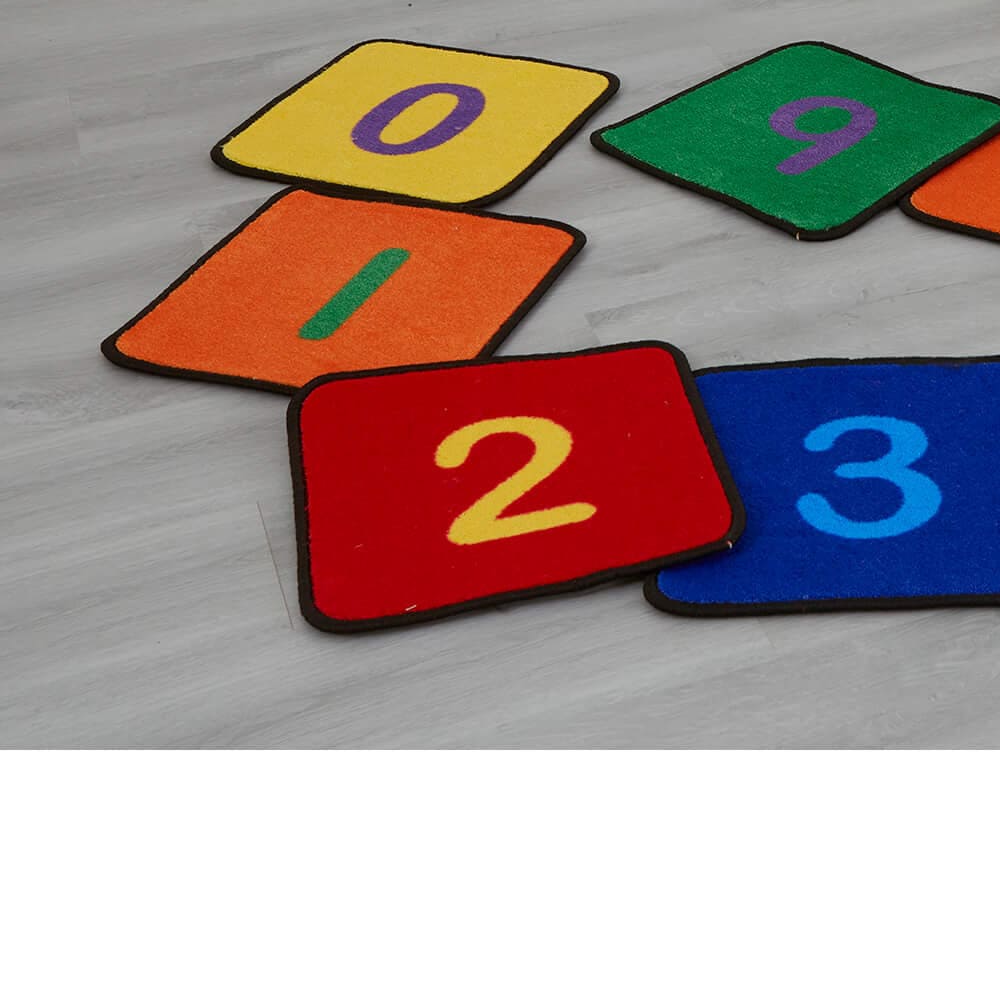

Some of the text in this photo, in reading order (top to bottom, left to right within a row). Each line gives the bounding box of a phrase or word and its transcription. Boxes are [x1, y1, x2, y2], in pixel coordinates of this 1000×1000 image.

[352, 83, 486, 155] 0
[770, 97, 878, 176] 9
[299, 248, 409, 340] 1
[436, 417, 595, 544] 2
[797, 416, 942, 539] 3
